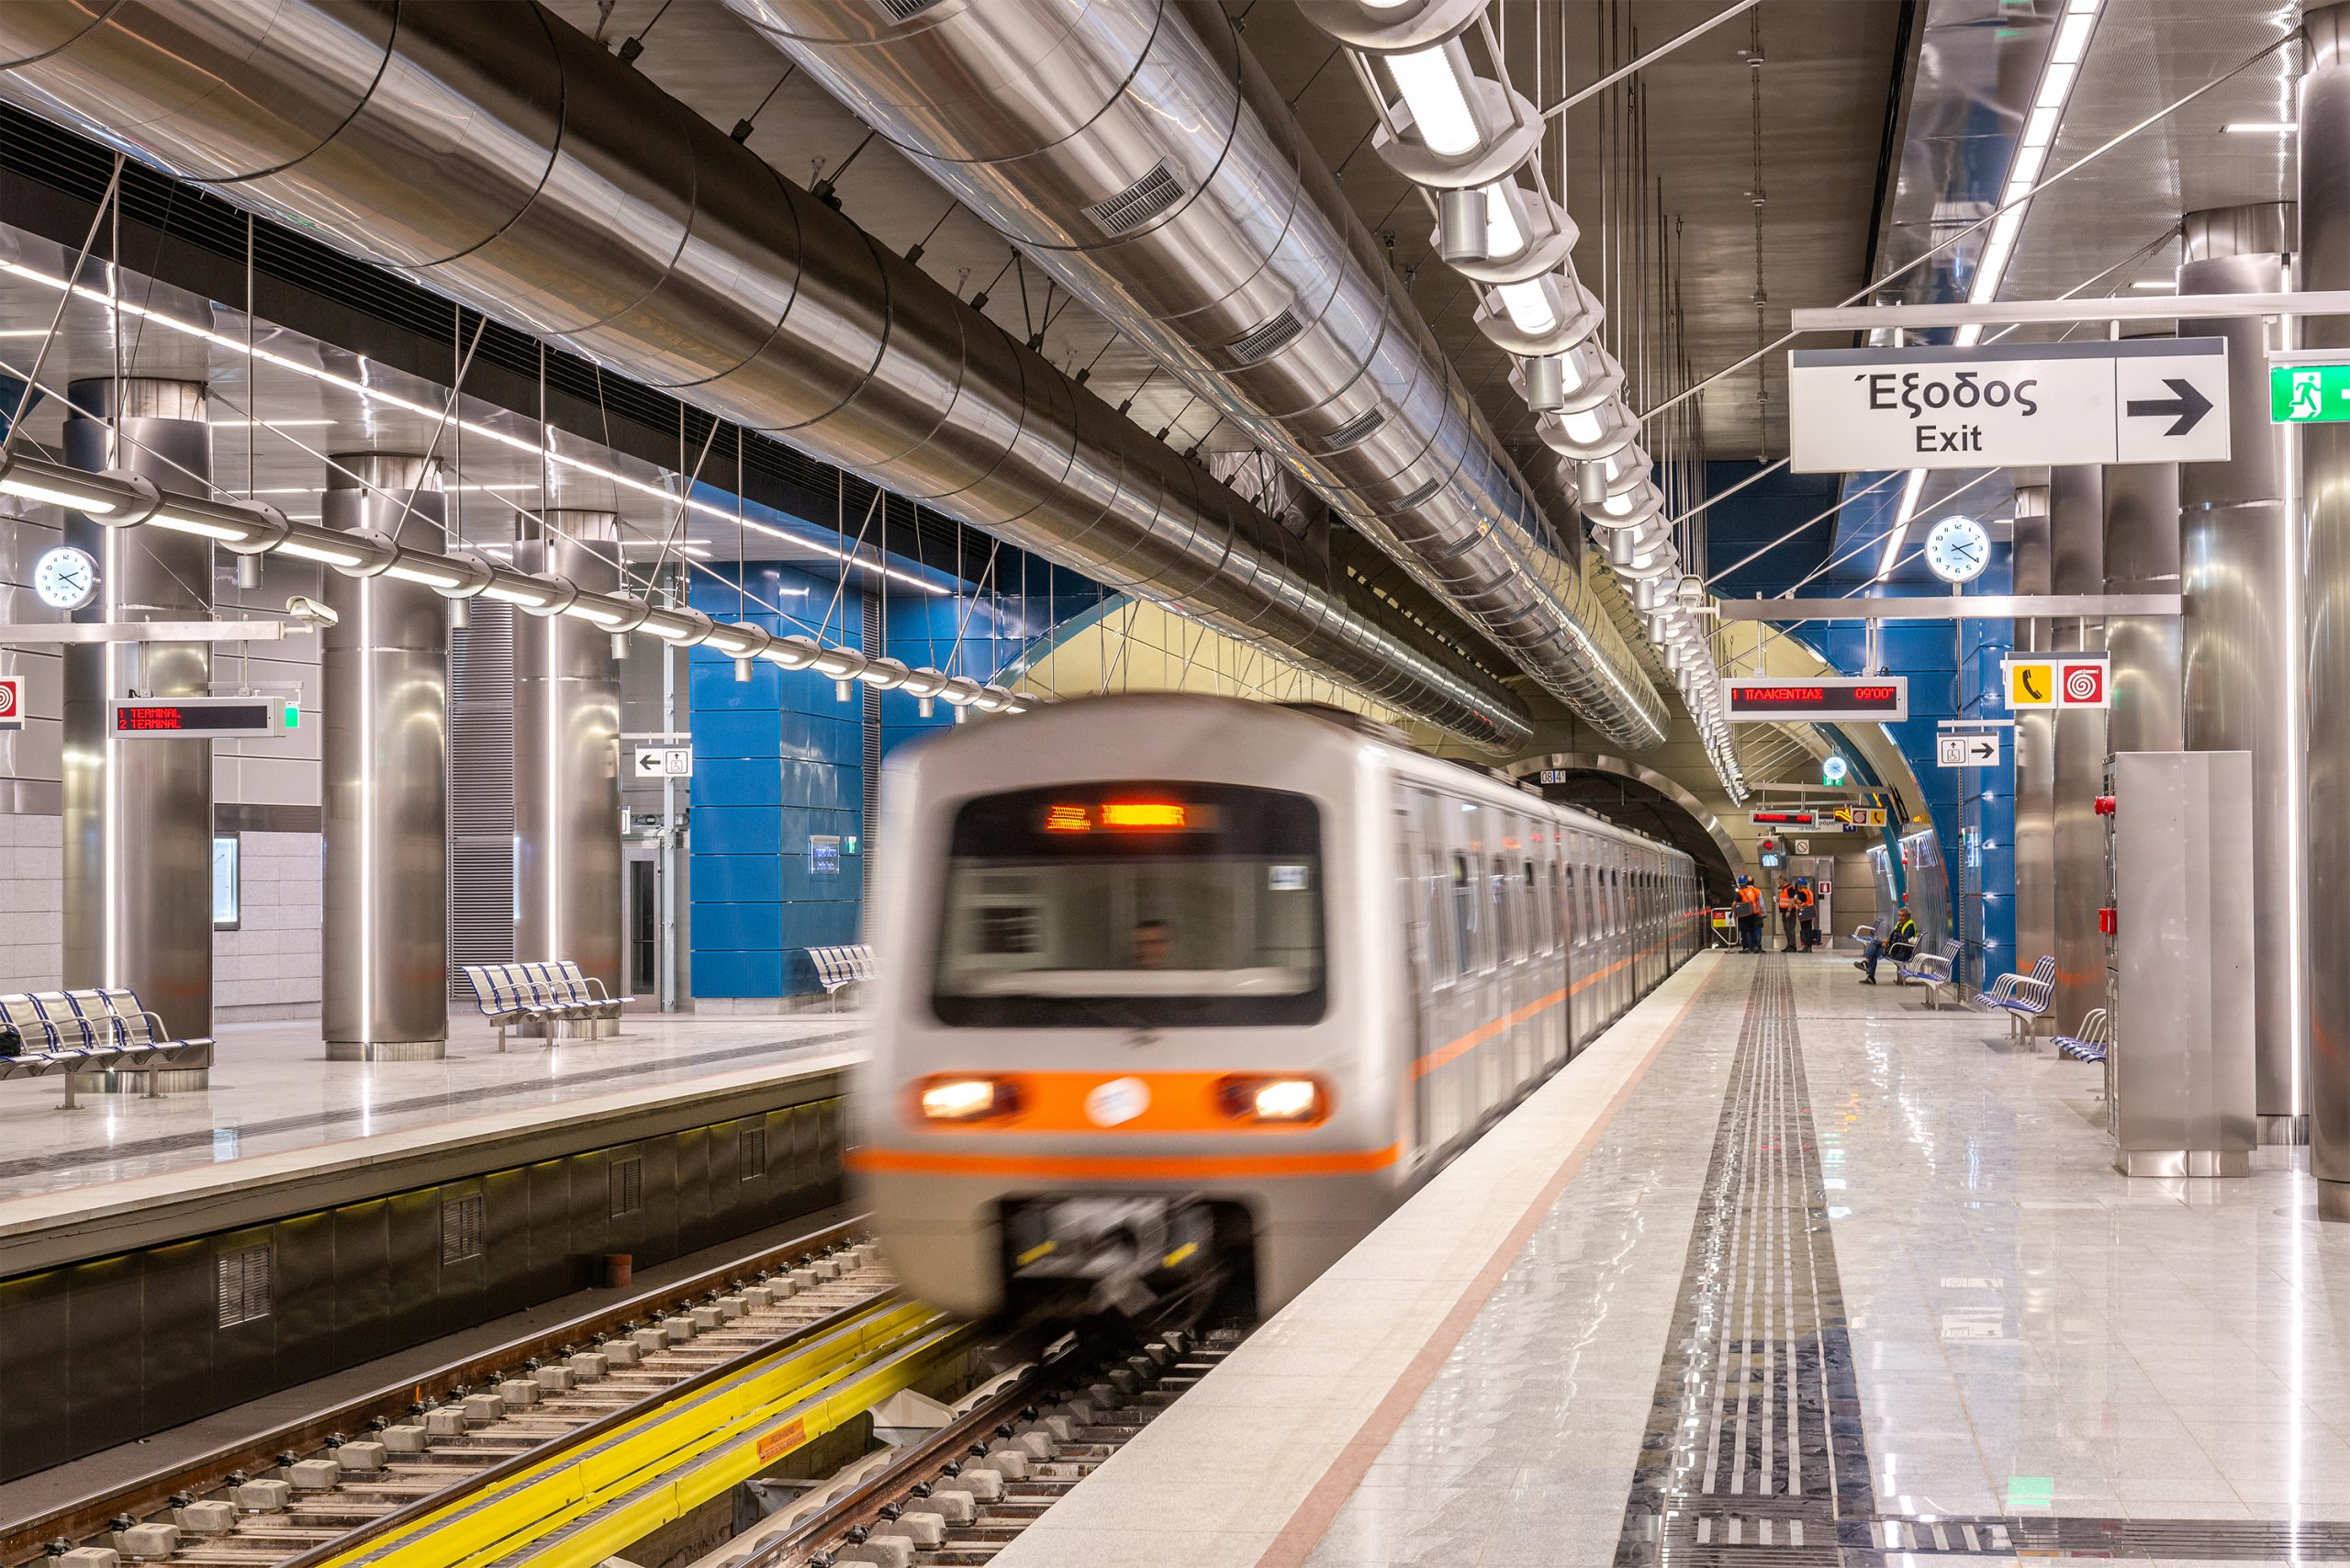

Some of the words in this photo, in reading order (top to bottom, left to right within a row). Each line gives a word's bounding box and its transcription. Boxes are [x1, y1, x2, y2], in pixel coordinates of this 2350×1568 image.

[1854, 372, 2038, 419] Έξοδος
[1916, 424, 1982, 452] Exit
[1732, 688, 1739, 700] 1
[1745, 688, 1822, 700] ΠΛΑΚΕΝΤΙΑΣ
[118, 708, 125, 719] 1
[130, 708, 182, 719] TERMINAL
[118, 719, 128, 729] 2
[130, 719, 182, 729] TERMINAL
